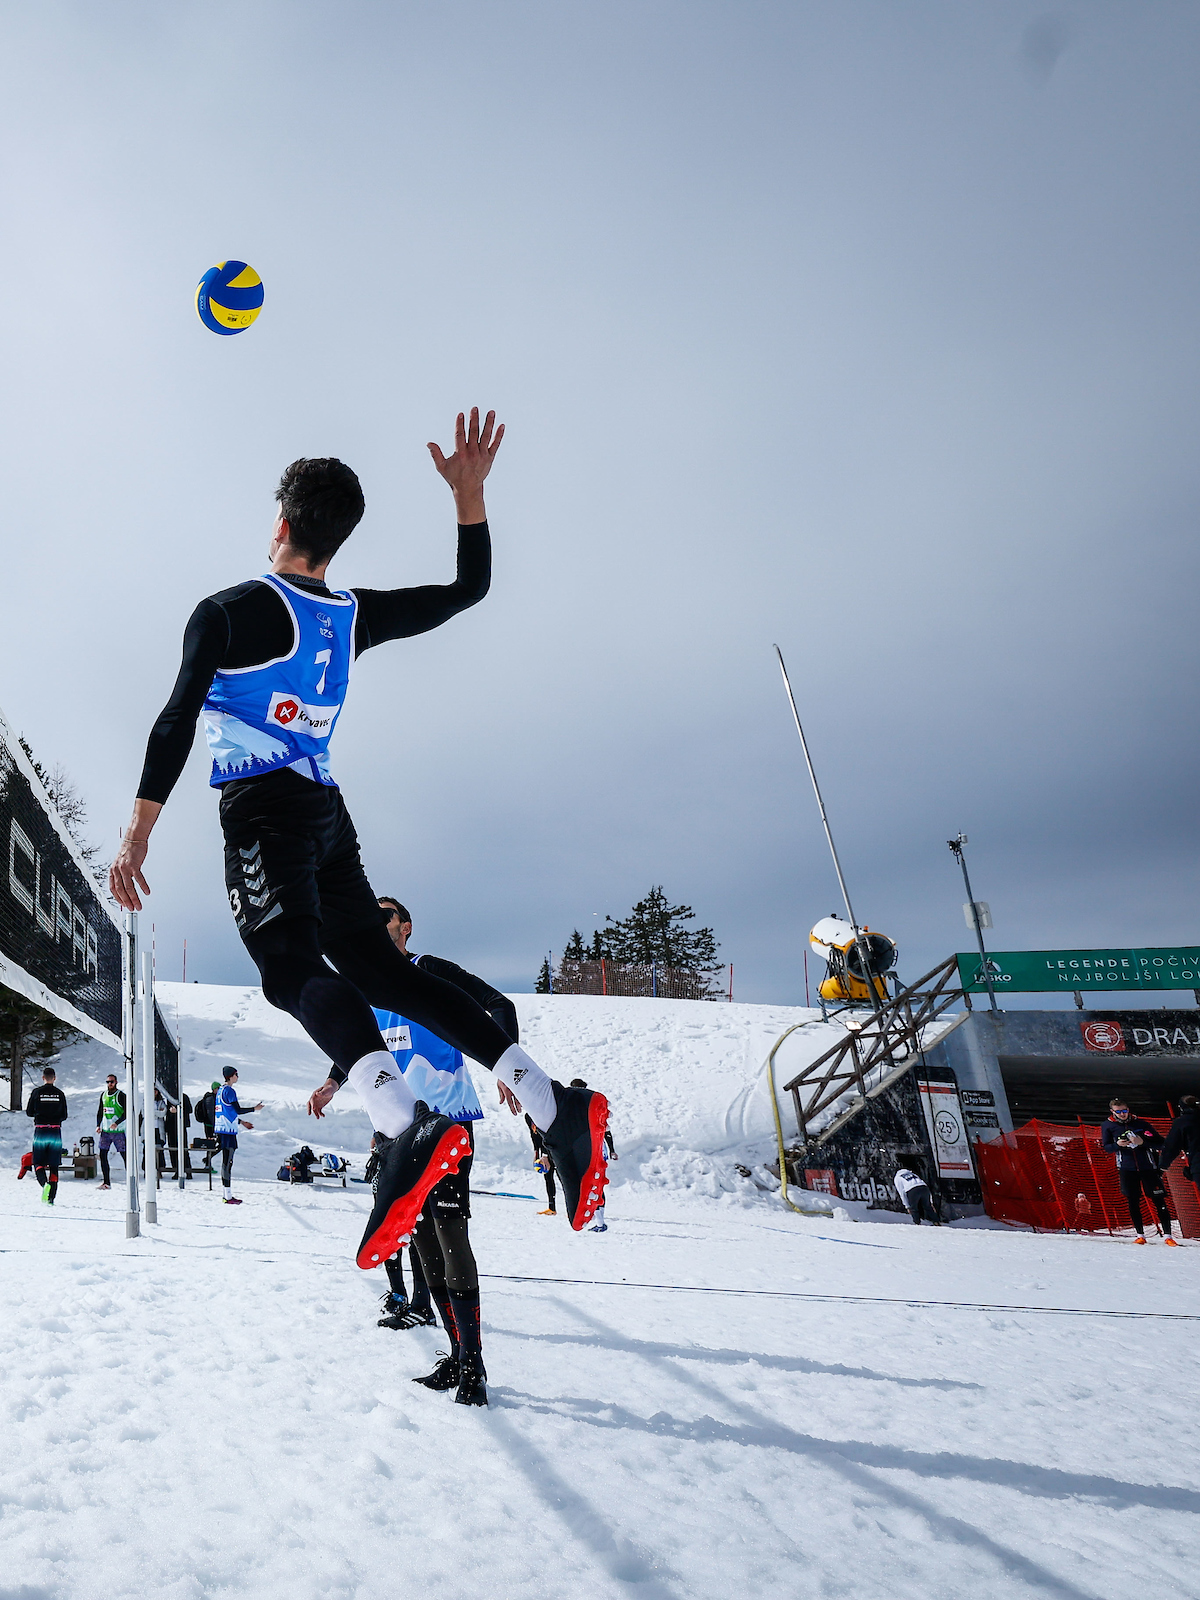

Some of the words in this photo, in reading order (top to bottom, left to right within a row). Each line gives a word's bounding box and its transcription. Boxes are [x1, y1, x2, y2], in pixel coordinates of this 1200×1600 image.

[314, 648, 333, 695] 7
[9, 816, 99, 984] CUPRA
[1046, 958, 1130, 969] LEGENDE
[1058, 971, 1160, 982] NAJBOLJŠI
[374, 1074, 398, 1089] adidas
[515, 1068, 529, 1086] adidas
